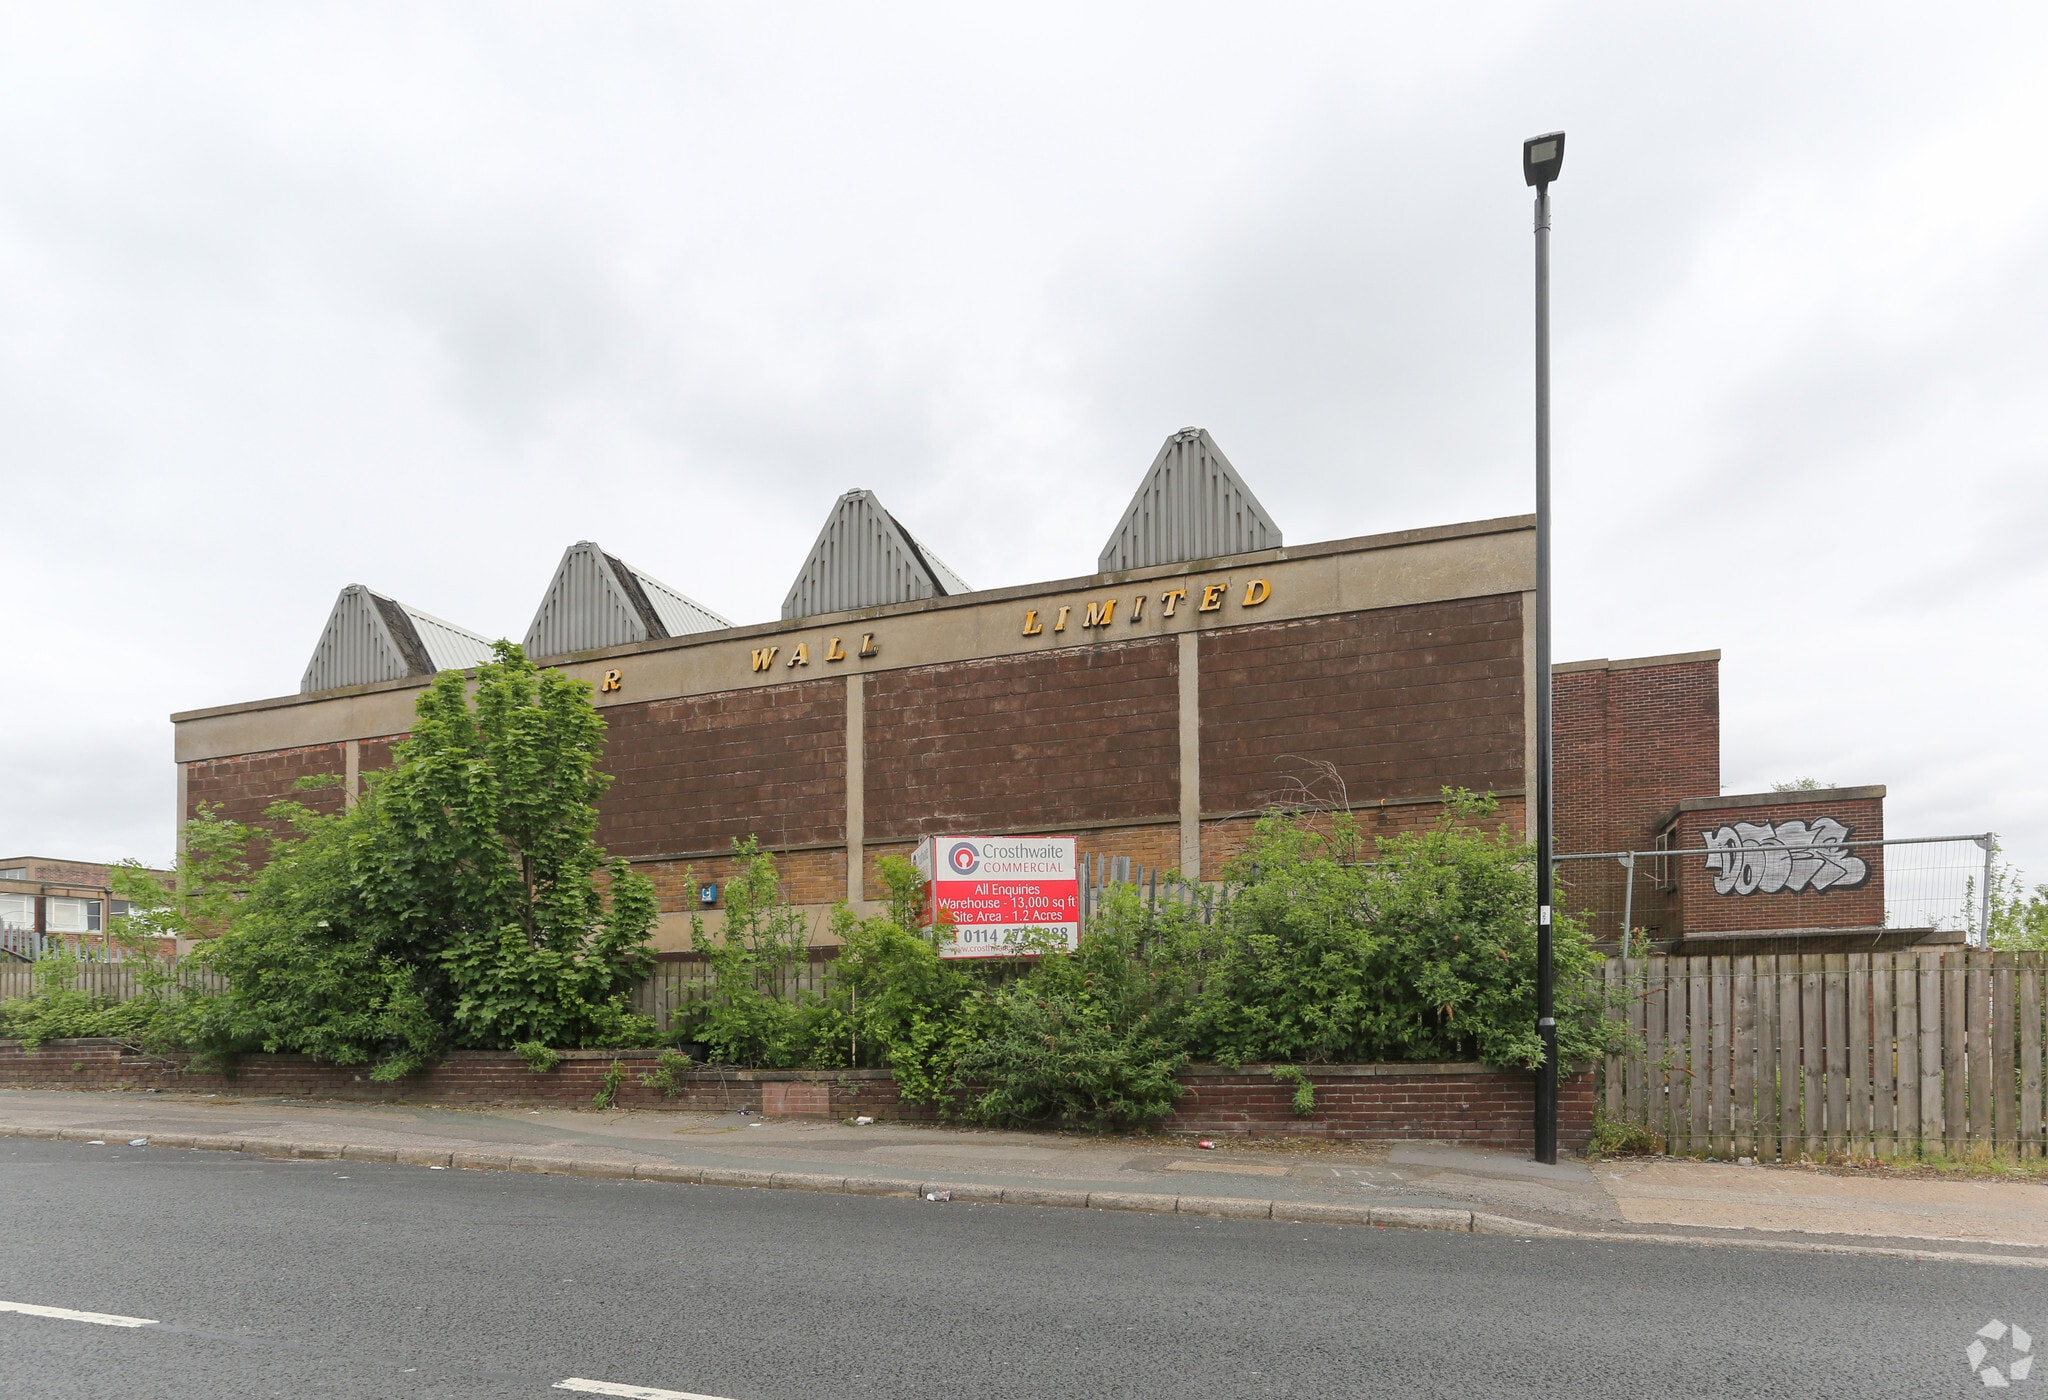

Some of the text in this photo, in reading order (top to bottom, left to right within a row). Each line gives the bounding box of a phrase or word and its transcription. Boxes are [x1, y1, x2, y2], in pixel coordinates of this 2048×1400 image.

[601, 578, 1272, 692] R WALL LIMITED
[983, 843, 1064, 859] Crosthwaite
[984, 862, 1064, 873] COMMERCIAL
[975, 883, 1040, 898] All Enquiries
[938, 897, 1000, 909] Warehouse
[1011, 896, 1049, 909] 13,000
[1052, 899, 1065, 910] sq
[1068, 895, 1076, 907] ft
[953, 911, 974, 922] Site
[976, 910, 1002, 922] Area
[1012, 910, 1030, 921] 1.2
[1032, 909, 1063, 920] Acres
[964, 929, 998, 943] 0114
